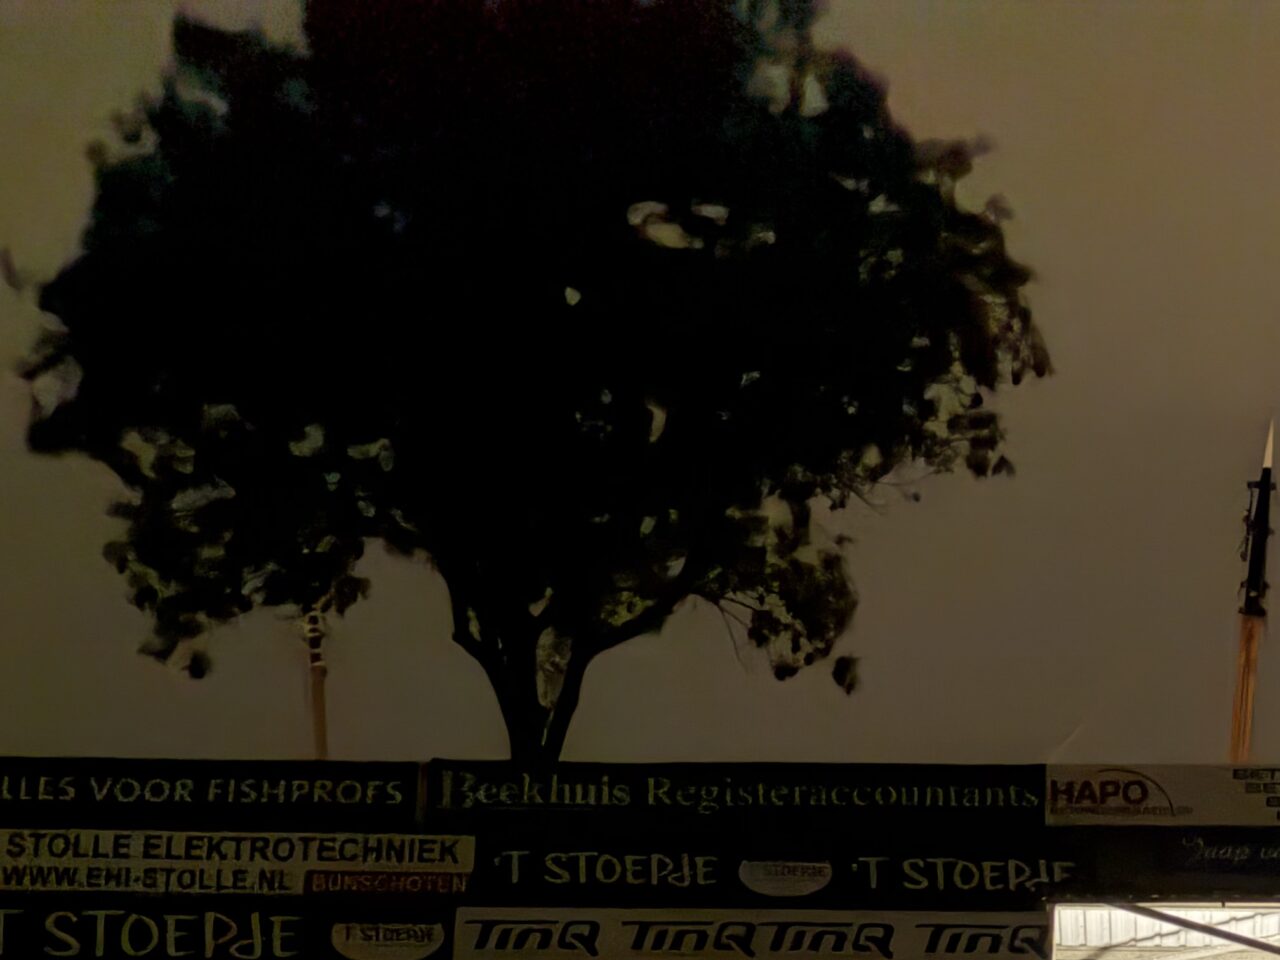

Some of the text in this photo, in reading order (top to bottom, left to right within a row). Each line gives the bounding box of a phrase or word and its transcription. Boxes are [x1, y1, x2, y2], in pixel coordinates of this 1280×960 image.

[90, 777, 193, 803] VOOR
[207, 778, 404, 804] FISHPROFS
[440, 767, 1041, 815] Beekhuis Registeraccountants
[1050, 779, 1149, 804] HAPO
[7, 834, 460, 865] STOLLE ELEKTROTECHNIEK
[2, 866, 290, 891] WWW.EHI-STOLLE.NL
